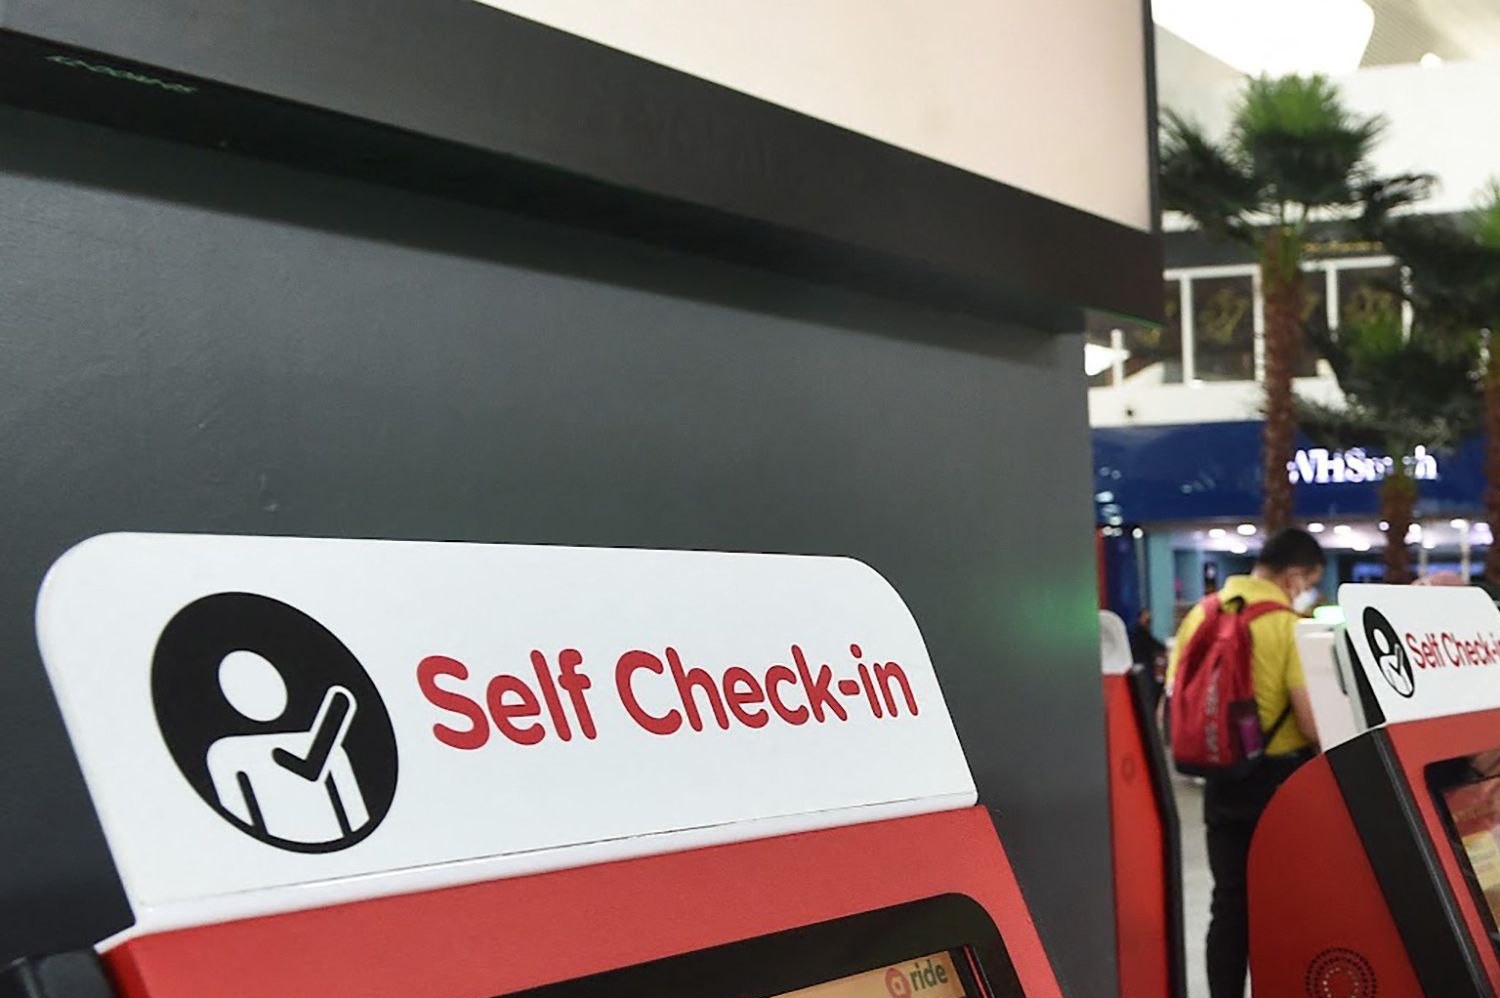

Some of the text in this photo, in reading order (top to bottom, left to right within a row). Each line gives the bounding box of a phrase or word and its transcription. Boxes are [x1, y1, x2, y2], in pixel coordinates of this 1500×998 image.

[1405, 632, 1446, 669] Self
[416, 643, 918, 750] Self Check-in
[910, 959, 949, 991] ride
